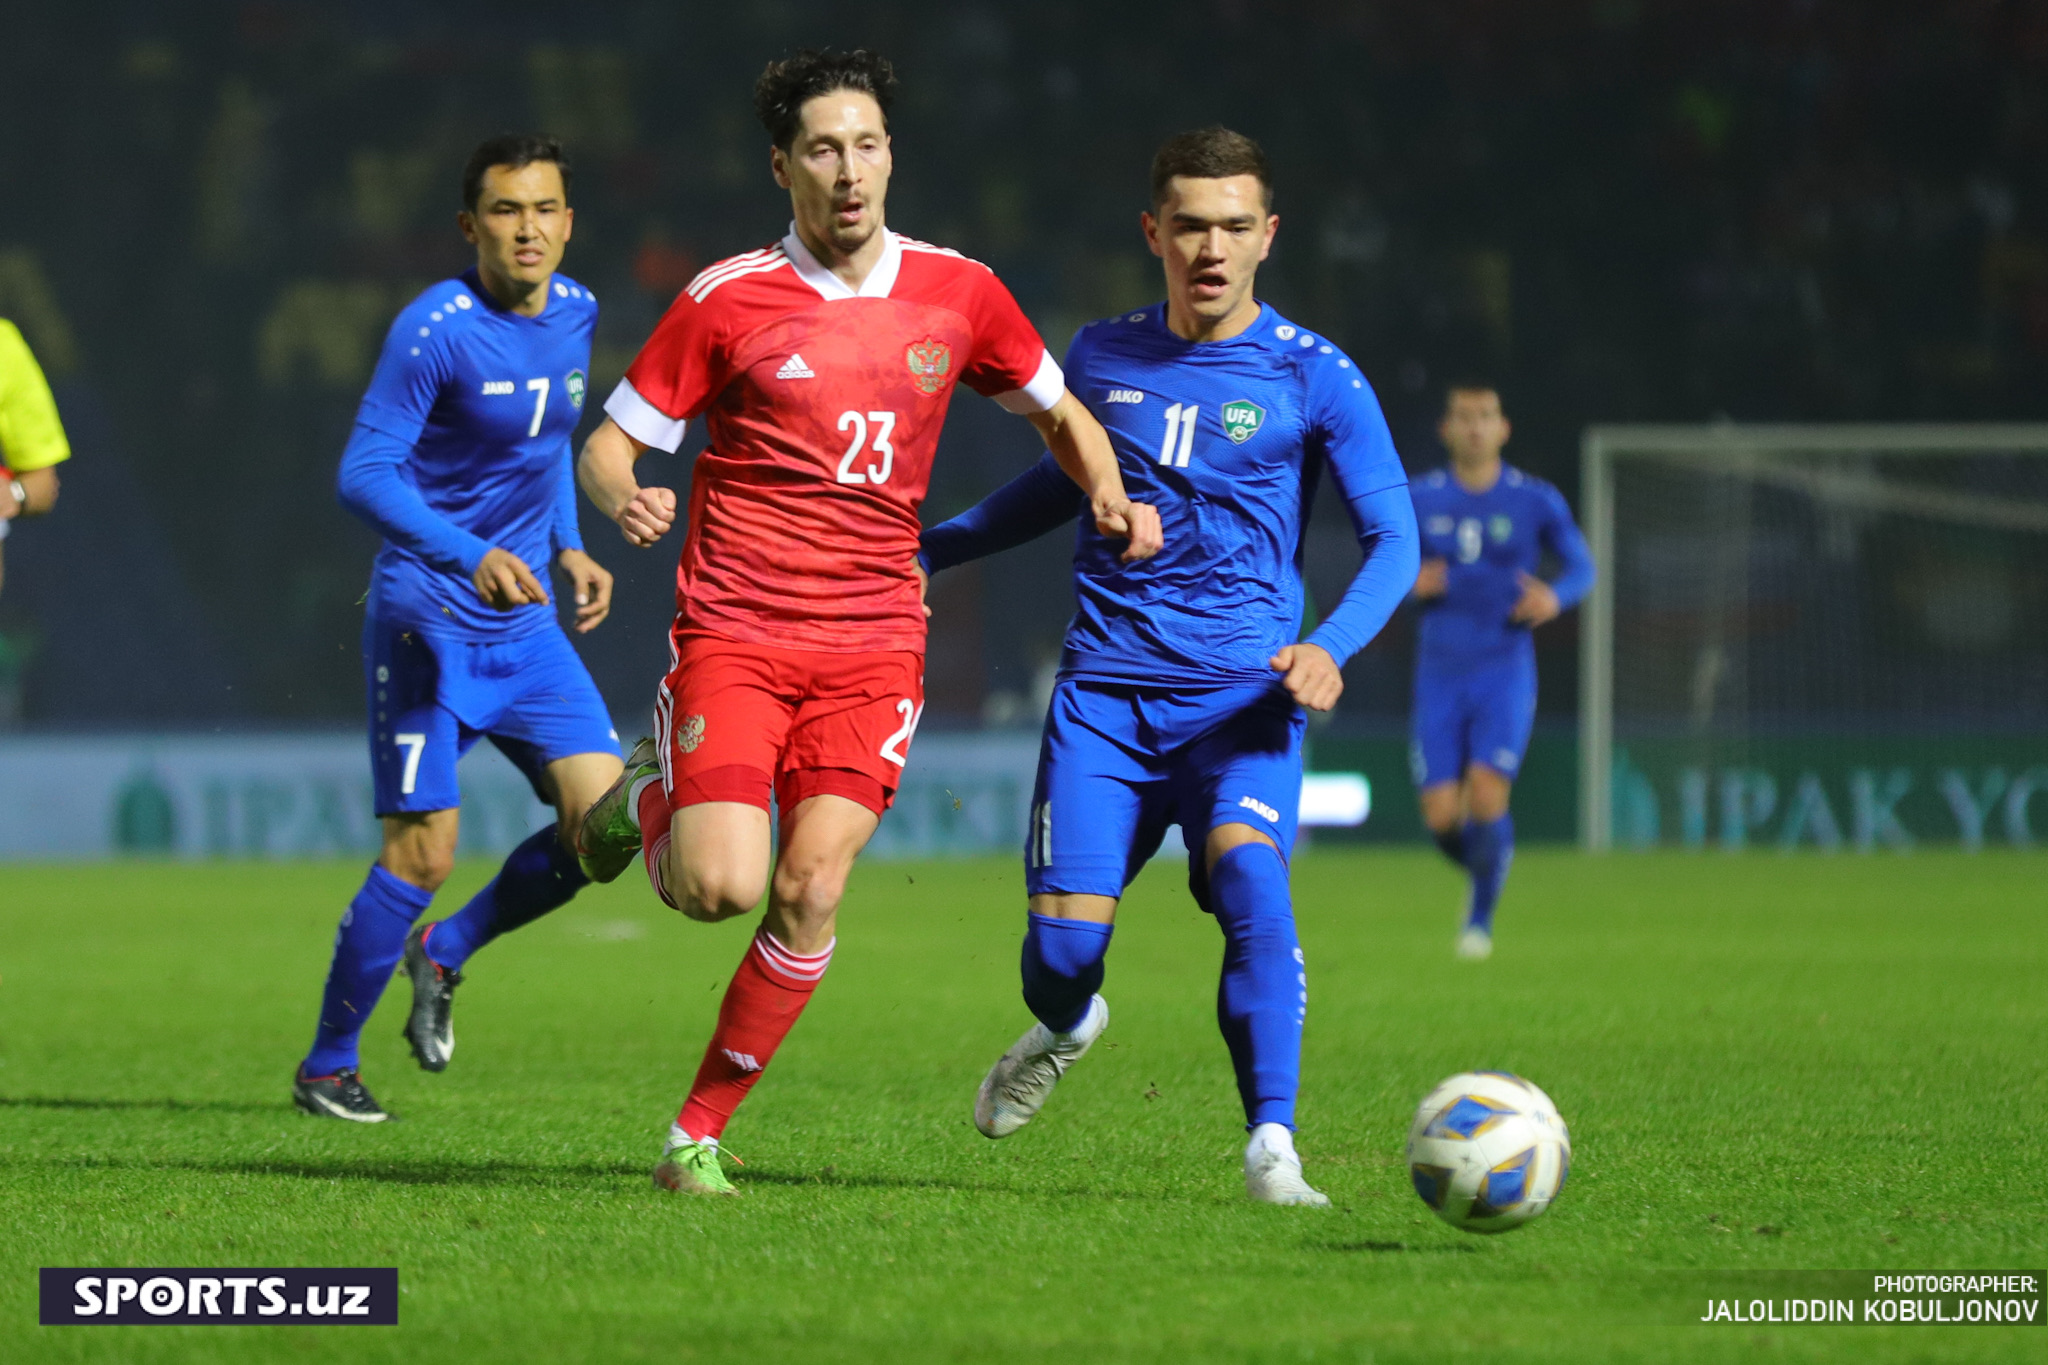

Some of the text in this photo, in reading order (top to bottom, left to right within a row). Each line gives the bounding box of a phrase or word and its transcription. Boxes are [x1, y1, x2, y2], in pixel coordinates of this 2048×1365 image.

[482, 380, 515, 396] JAKO
[526, 377, 550, 438] 7
[1106, 390, 1145, 404] JAKO
[1225, 407, 1257, 426] UFA
[836, 410, 896, 485] 23
[1158, 402, 1199, 468] 11
[394, 733, 427, 794] 7
[1032, 800, 1053, 868] 11
[1238, 795, 1280, 823] JAKO
[1681, 766, 1916, 853] IPAK
